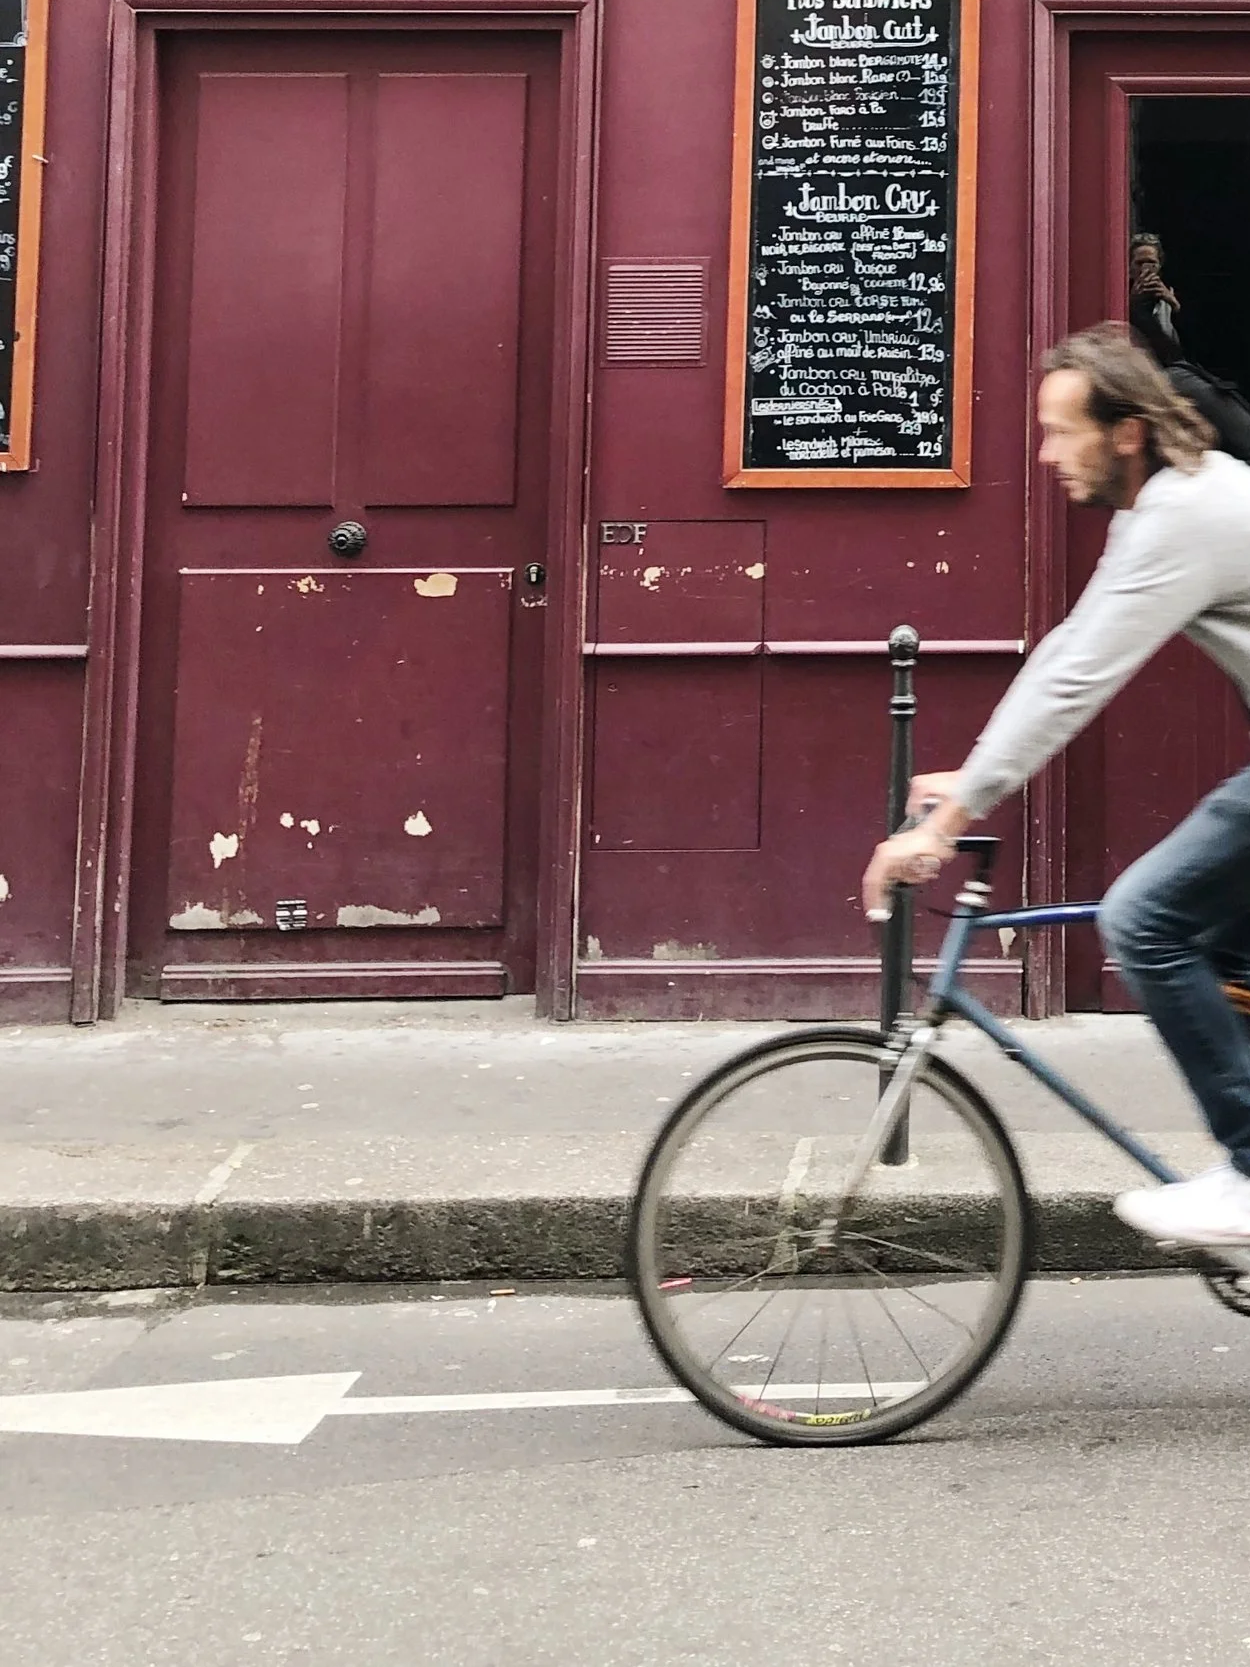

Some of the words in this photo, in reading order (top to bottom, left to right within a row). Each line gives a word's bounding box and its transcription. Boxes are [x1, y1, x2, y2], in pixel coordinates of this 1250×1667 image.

[803, 13, 880, 41] Jambon
[883, 15, 924, 40] Cuit
[781, 53, 826, 70] Jambon
[829, 56, 858, 67] blanc
[781, 71, 826, 87] Jambon
[829, 72, 858, 84] blanc
[780, 106, 826, 117] Jambon
[781, 134, 827, 149] Jambon
[798, 183, 880, 212] Jambon
[778, 226, 822, 242] Jambon
[777, 260, 822, 275] Jambon
[777, 294, 827, 308] Jambon
[777, 329, 830, 343] Jambon
[779, 365, 838, 380] Jambon
[780, 382, 795, 396] du
[799, 383, 854, 396] Cochon
